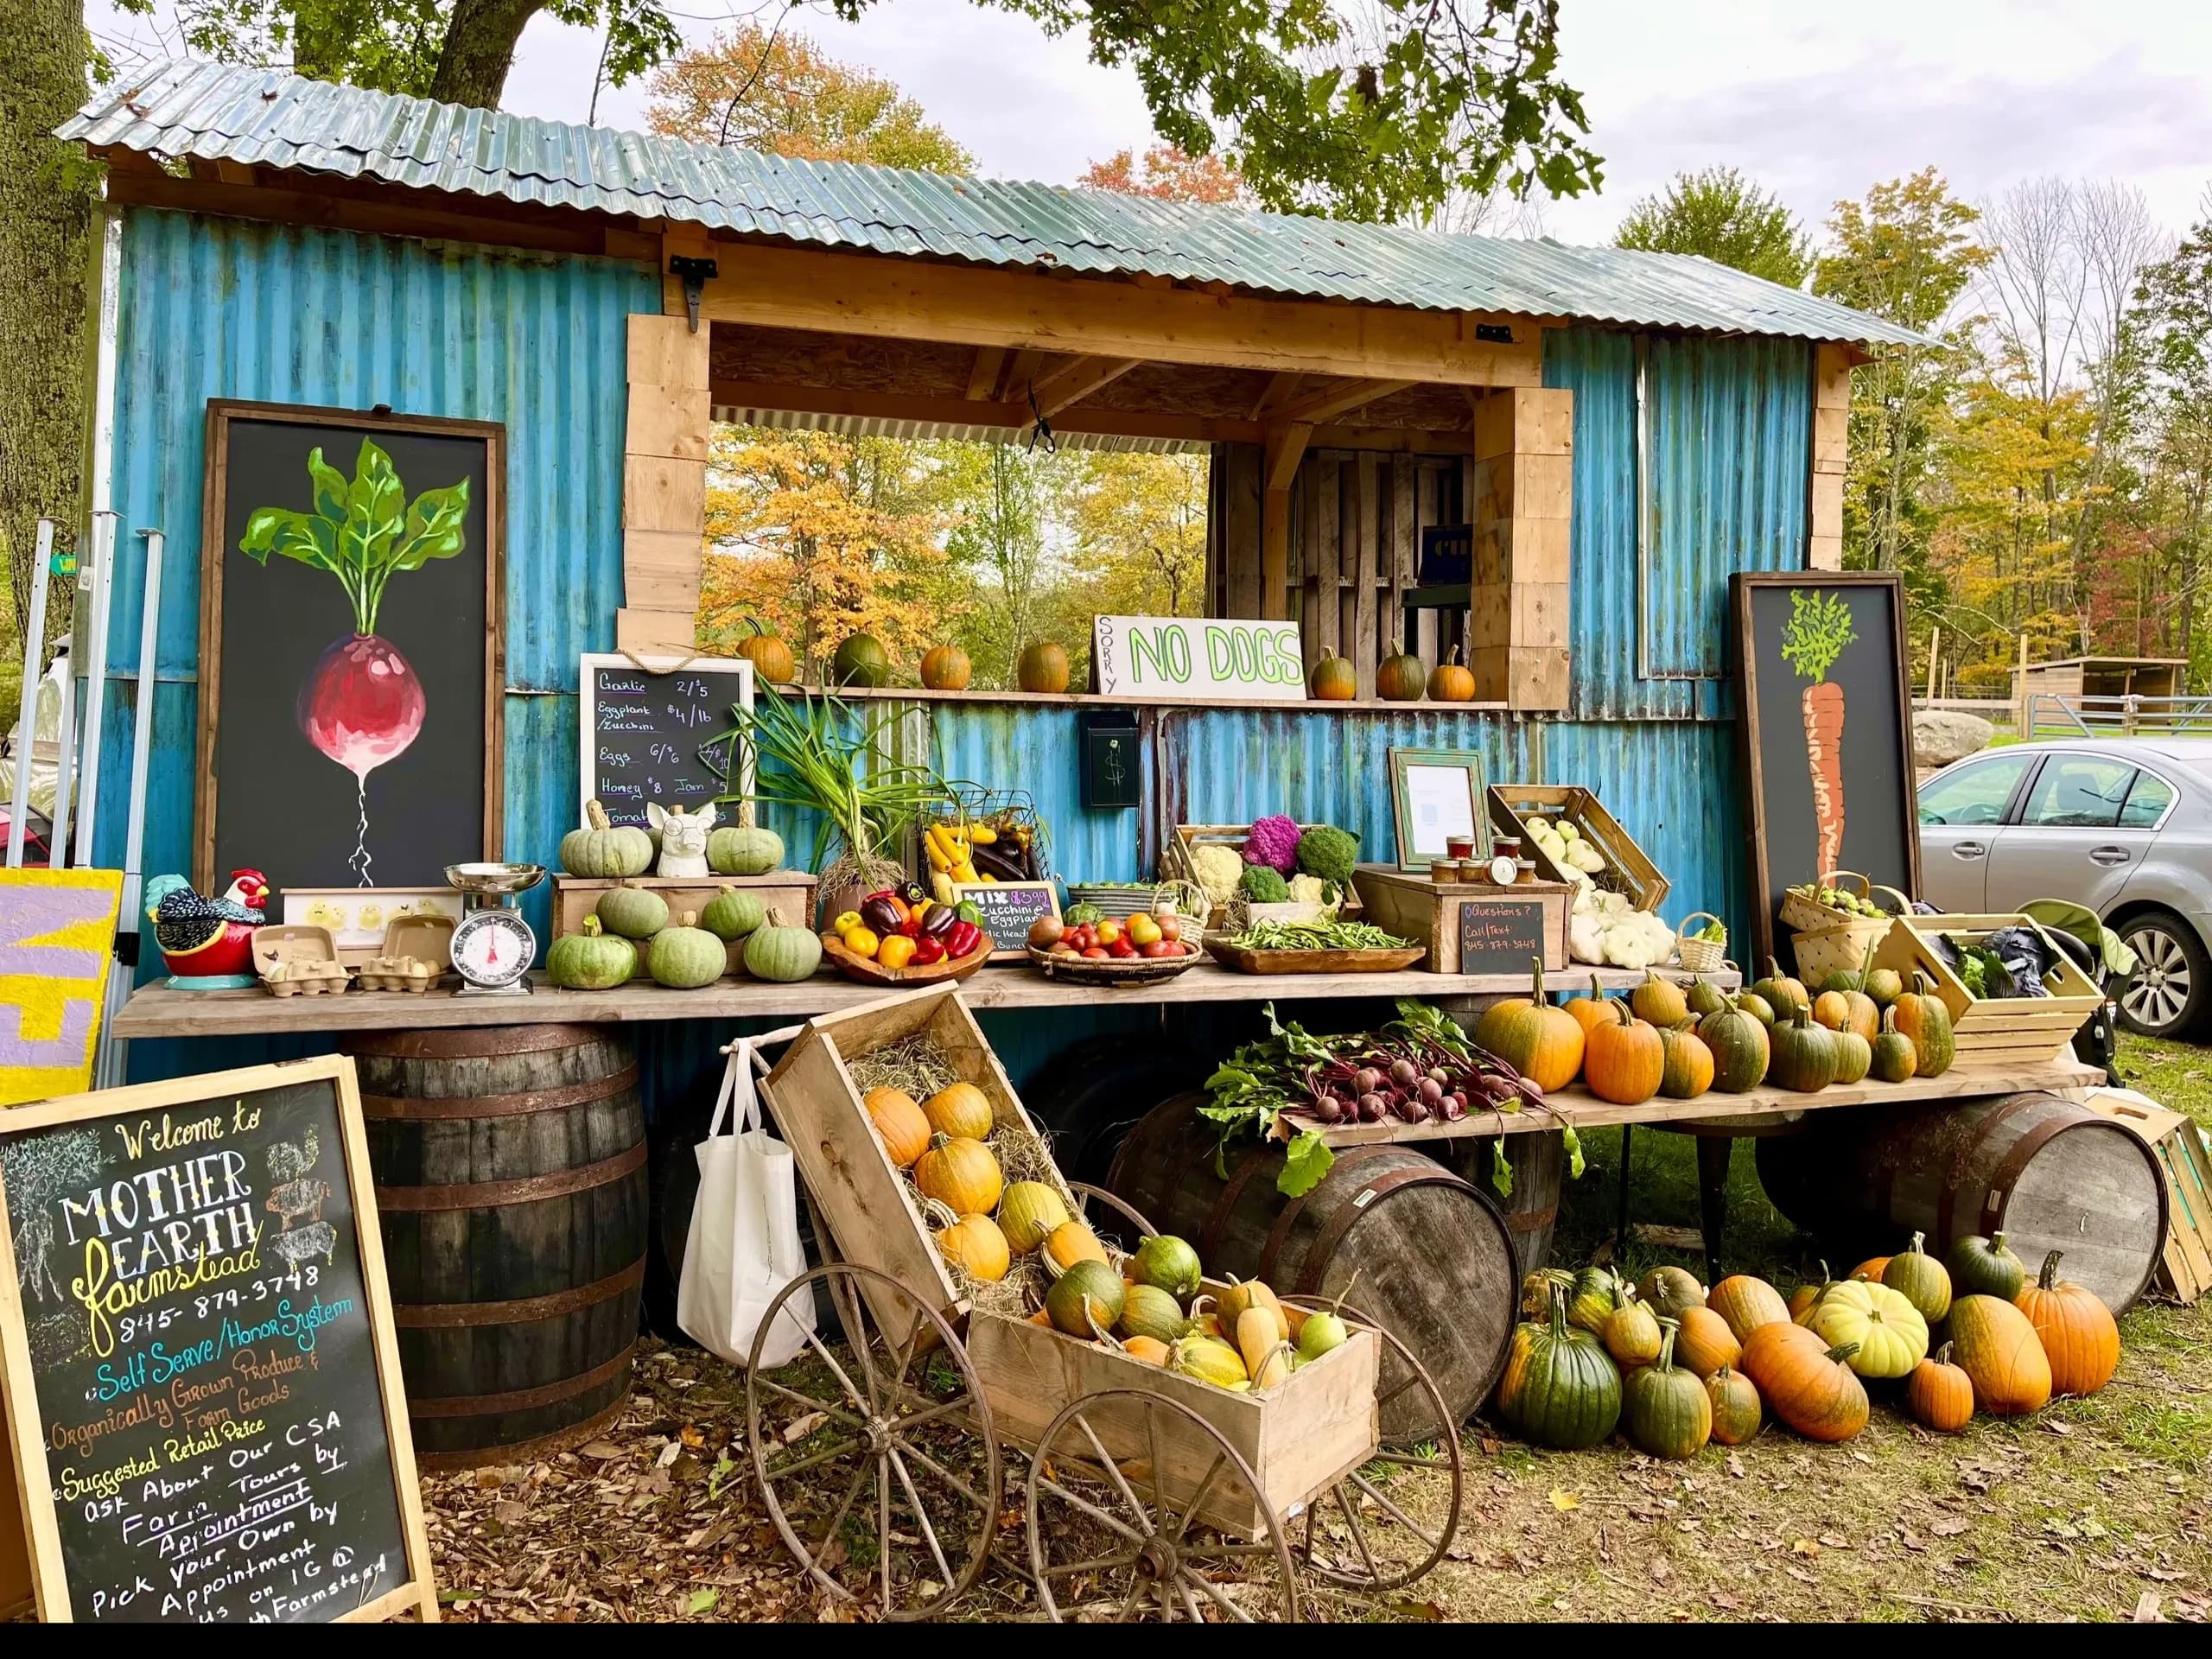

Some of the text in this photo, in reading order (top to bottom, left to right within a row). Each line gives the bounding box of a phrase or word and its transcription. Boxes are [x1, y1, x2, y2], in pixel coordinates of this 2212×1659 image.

[599, 672, 645, 693] Garlic
[1098, 616, 1117, 694] SORRY
[1128, 624, 1306, 686] NO DOGS
[597, 701, 651, 719] Eggplant
[599, 747, 631, 767] Eggs
[601, 779, 644, 801] Honey
[978, 905, 1033, 916] Zucchini
[990, 913, 1043, 927] Eggplan
[1002, 929, 1028, 938] Head
[114, 1099, 262, 1160] Welcome to
[58, 1150, 252, 1246] MOTHER
[110, 1203, 258, 1281] EARTH
[72, 1220, 264, 1358] farmstead
[97, 1351, 147, 1401] Self
[277, 1294, 353, 1351] System
[51, 1393, 175, 1459] Organically
[232, 1349, 304, 1382] Produce
[238, 1378, 290, 1414] Goods
[61, 1417, 266, 1502] Suggested Retail Price
[143, 1465, 214, 1503] About
[228, 1441, 273, 1468] Our
[286, 1410, 342, 1446] CSA
[227, 1462, 302, 1493] Tours
[315, 1443, 339, 1471] by
[92, 1577, 155, 1618] Pick
[237, 1520, 296, 1553] Own
[309, 1501, 338, 1527] by
[159, 1538, 317, 1617] Appointment
[249, 1586, 274, 1605] on
[332, 1545, 355, 1568] @
